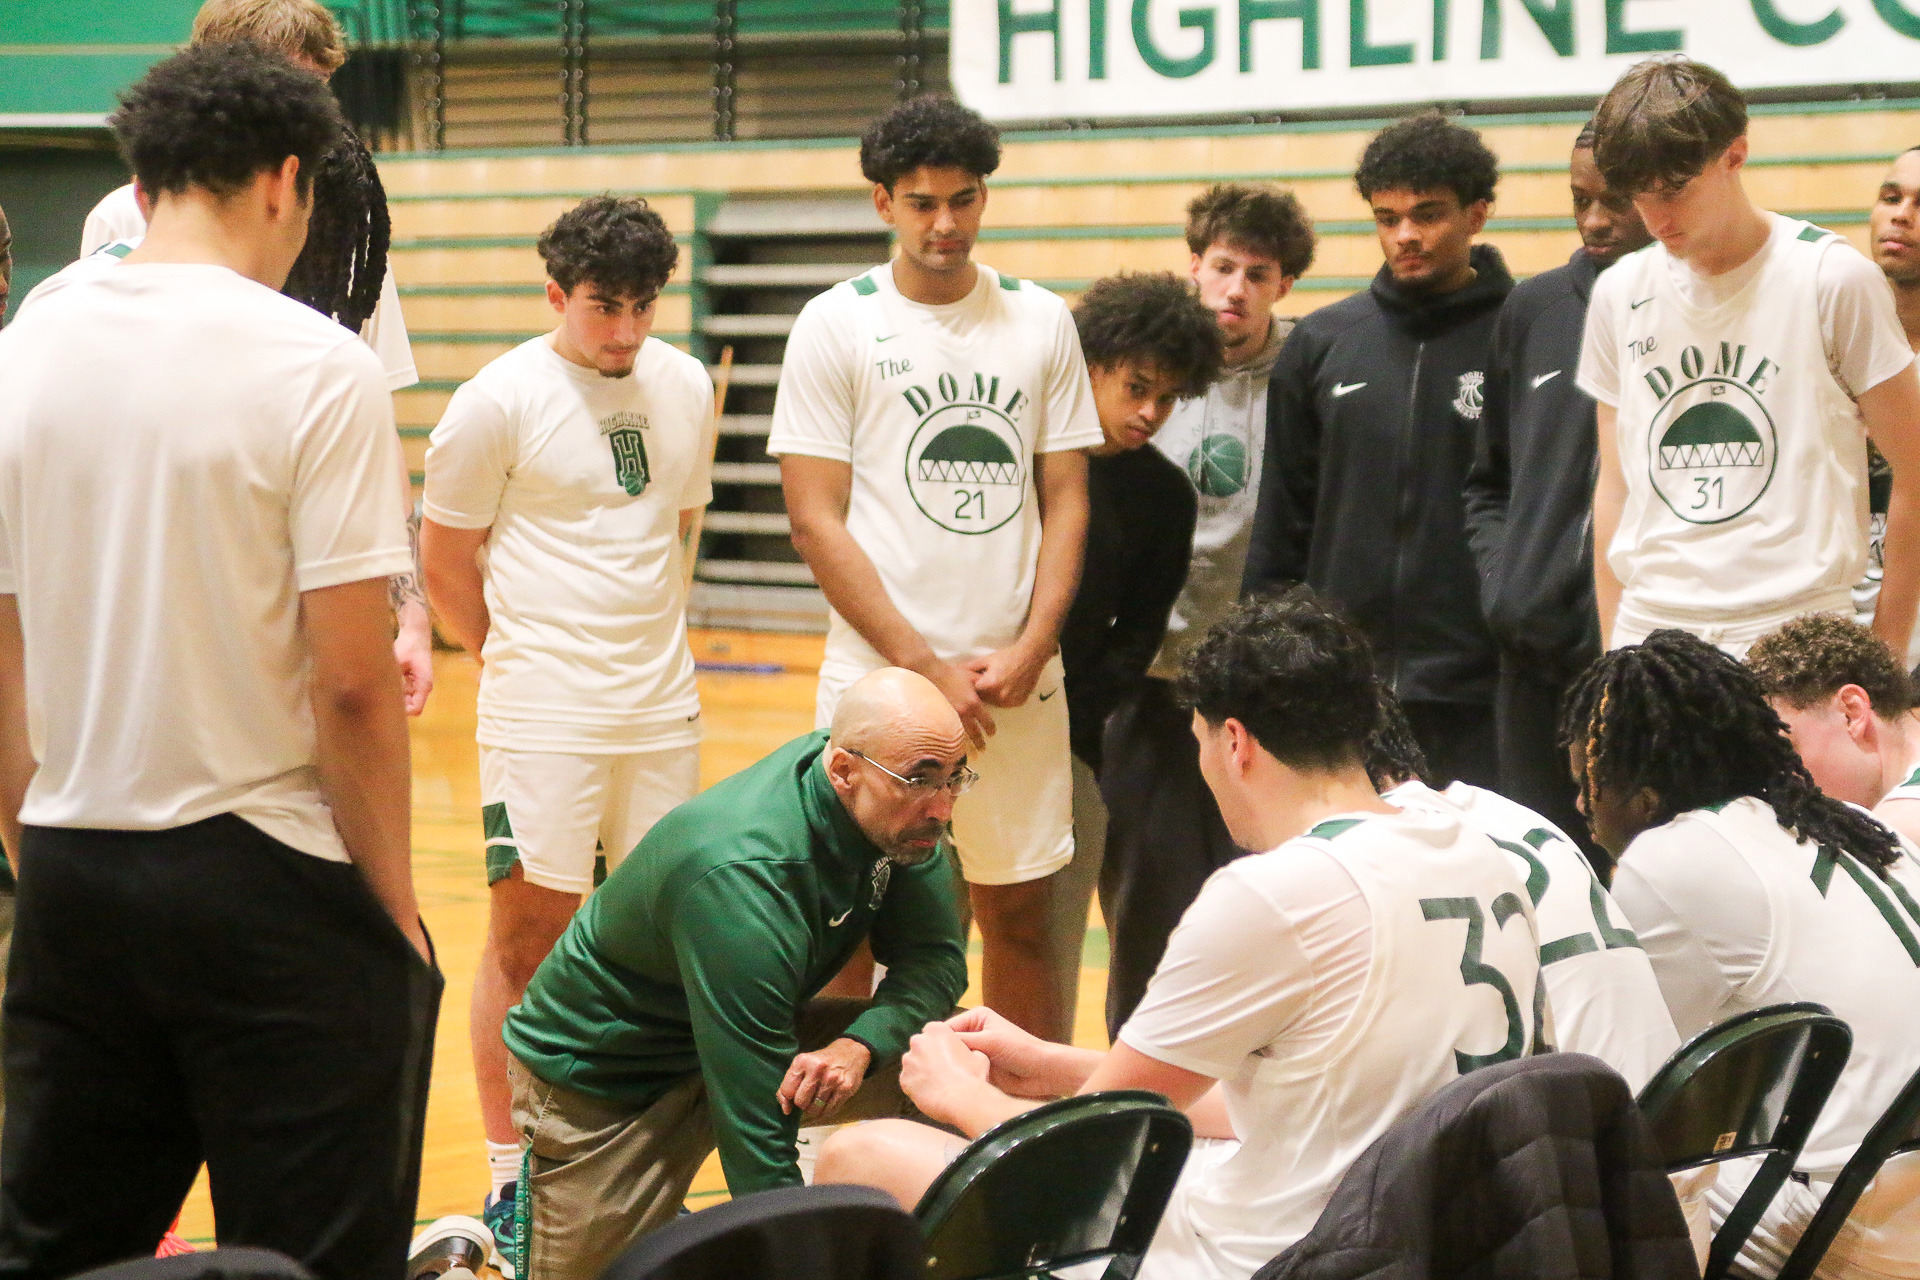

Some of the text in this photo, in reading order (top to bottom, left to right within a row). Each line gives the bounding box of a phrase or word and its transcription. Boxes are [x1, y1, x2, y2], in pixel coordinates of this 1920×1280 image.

[875, 357, 915, 381] The
[1628, 335, 1659, 363] The
[1643, 340, 1781, 401] DOME
[902, 371, 1030, 423] DOME
[953, 488, 986, 521] 21
[1690, 475, 1725, 510] 31
[1418, 891, 1552, 1076] 32
[515, 1222, 525, 1276] COLLEGE
